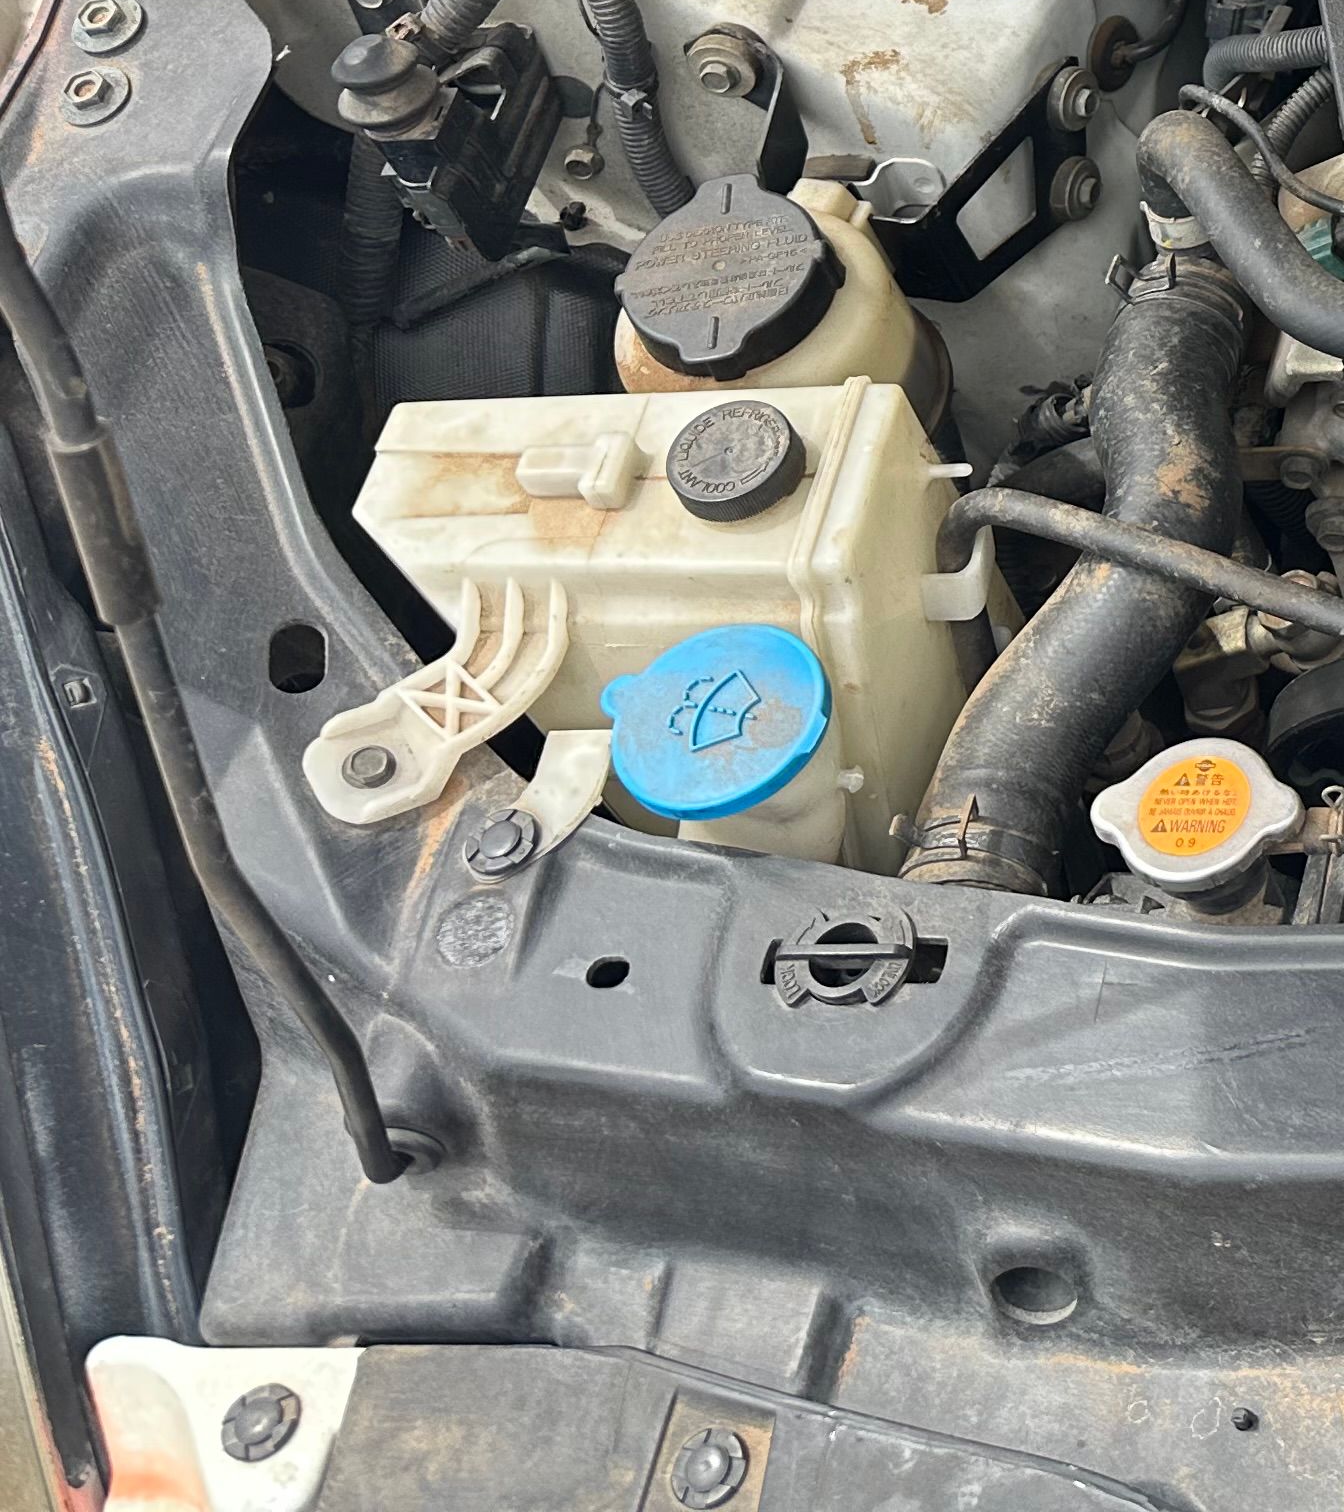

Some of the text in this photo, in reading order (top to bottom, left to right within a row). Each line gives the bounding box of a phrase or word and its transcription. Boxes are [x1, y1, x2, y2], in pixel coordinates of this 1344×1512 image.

[753, 225, 794, 237] LEVEL
[635, 234, 808, 271] POWER STEERING FLUID
[676, 416, 716, 463] LIQUIDE
[678, 469, 736, 494] COOLANT
[1178, 797, 1196, 806] OPEN
[1199, 797, 1220, 806] WHEN
[1169, 819, 1227, 834] WARNING
